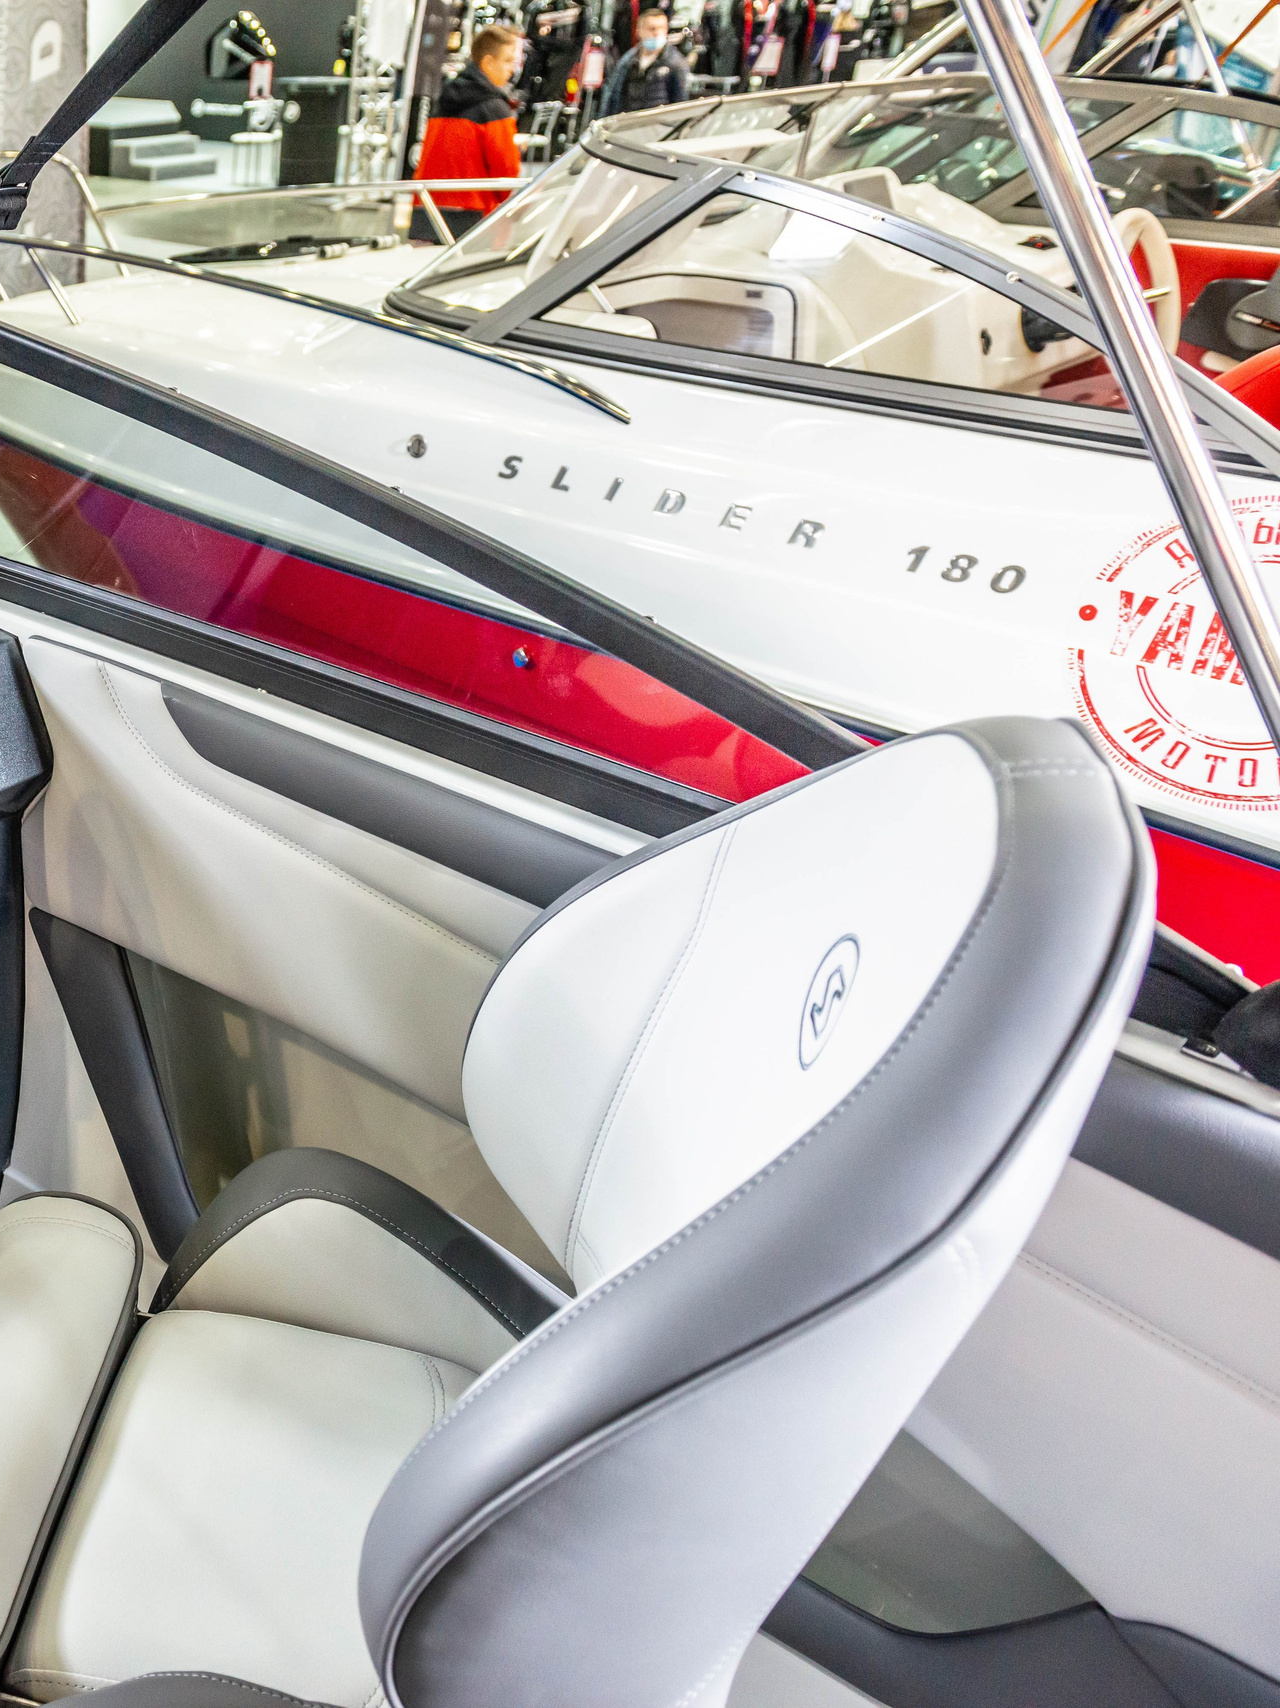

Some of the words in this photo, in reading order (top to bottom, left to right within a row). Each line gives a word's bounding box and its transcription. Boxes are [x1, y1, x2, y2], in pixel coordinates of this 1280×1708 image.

[498, 455, 826, 549] SLIDER
[906, 545, 1028, 594] 180
[1123, 717, 1280, 788] MOTO
